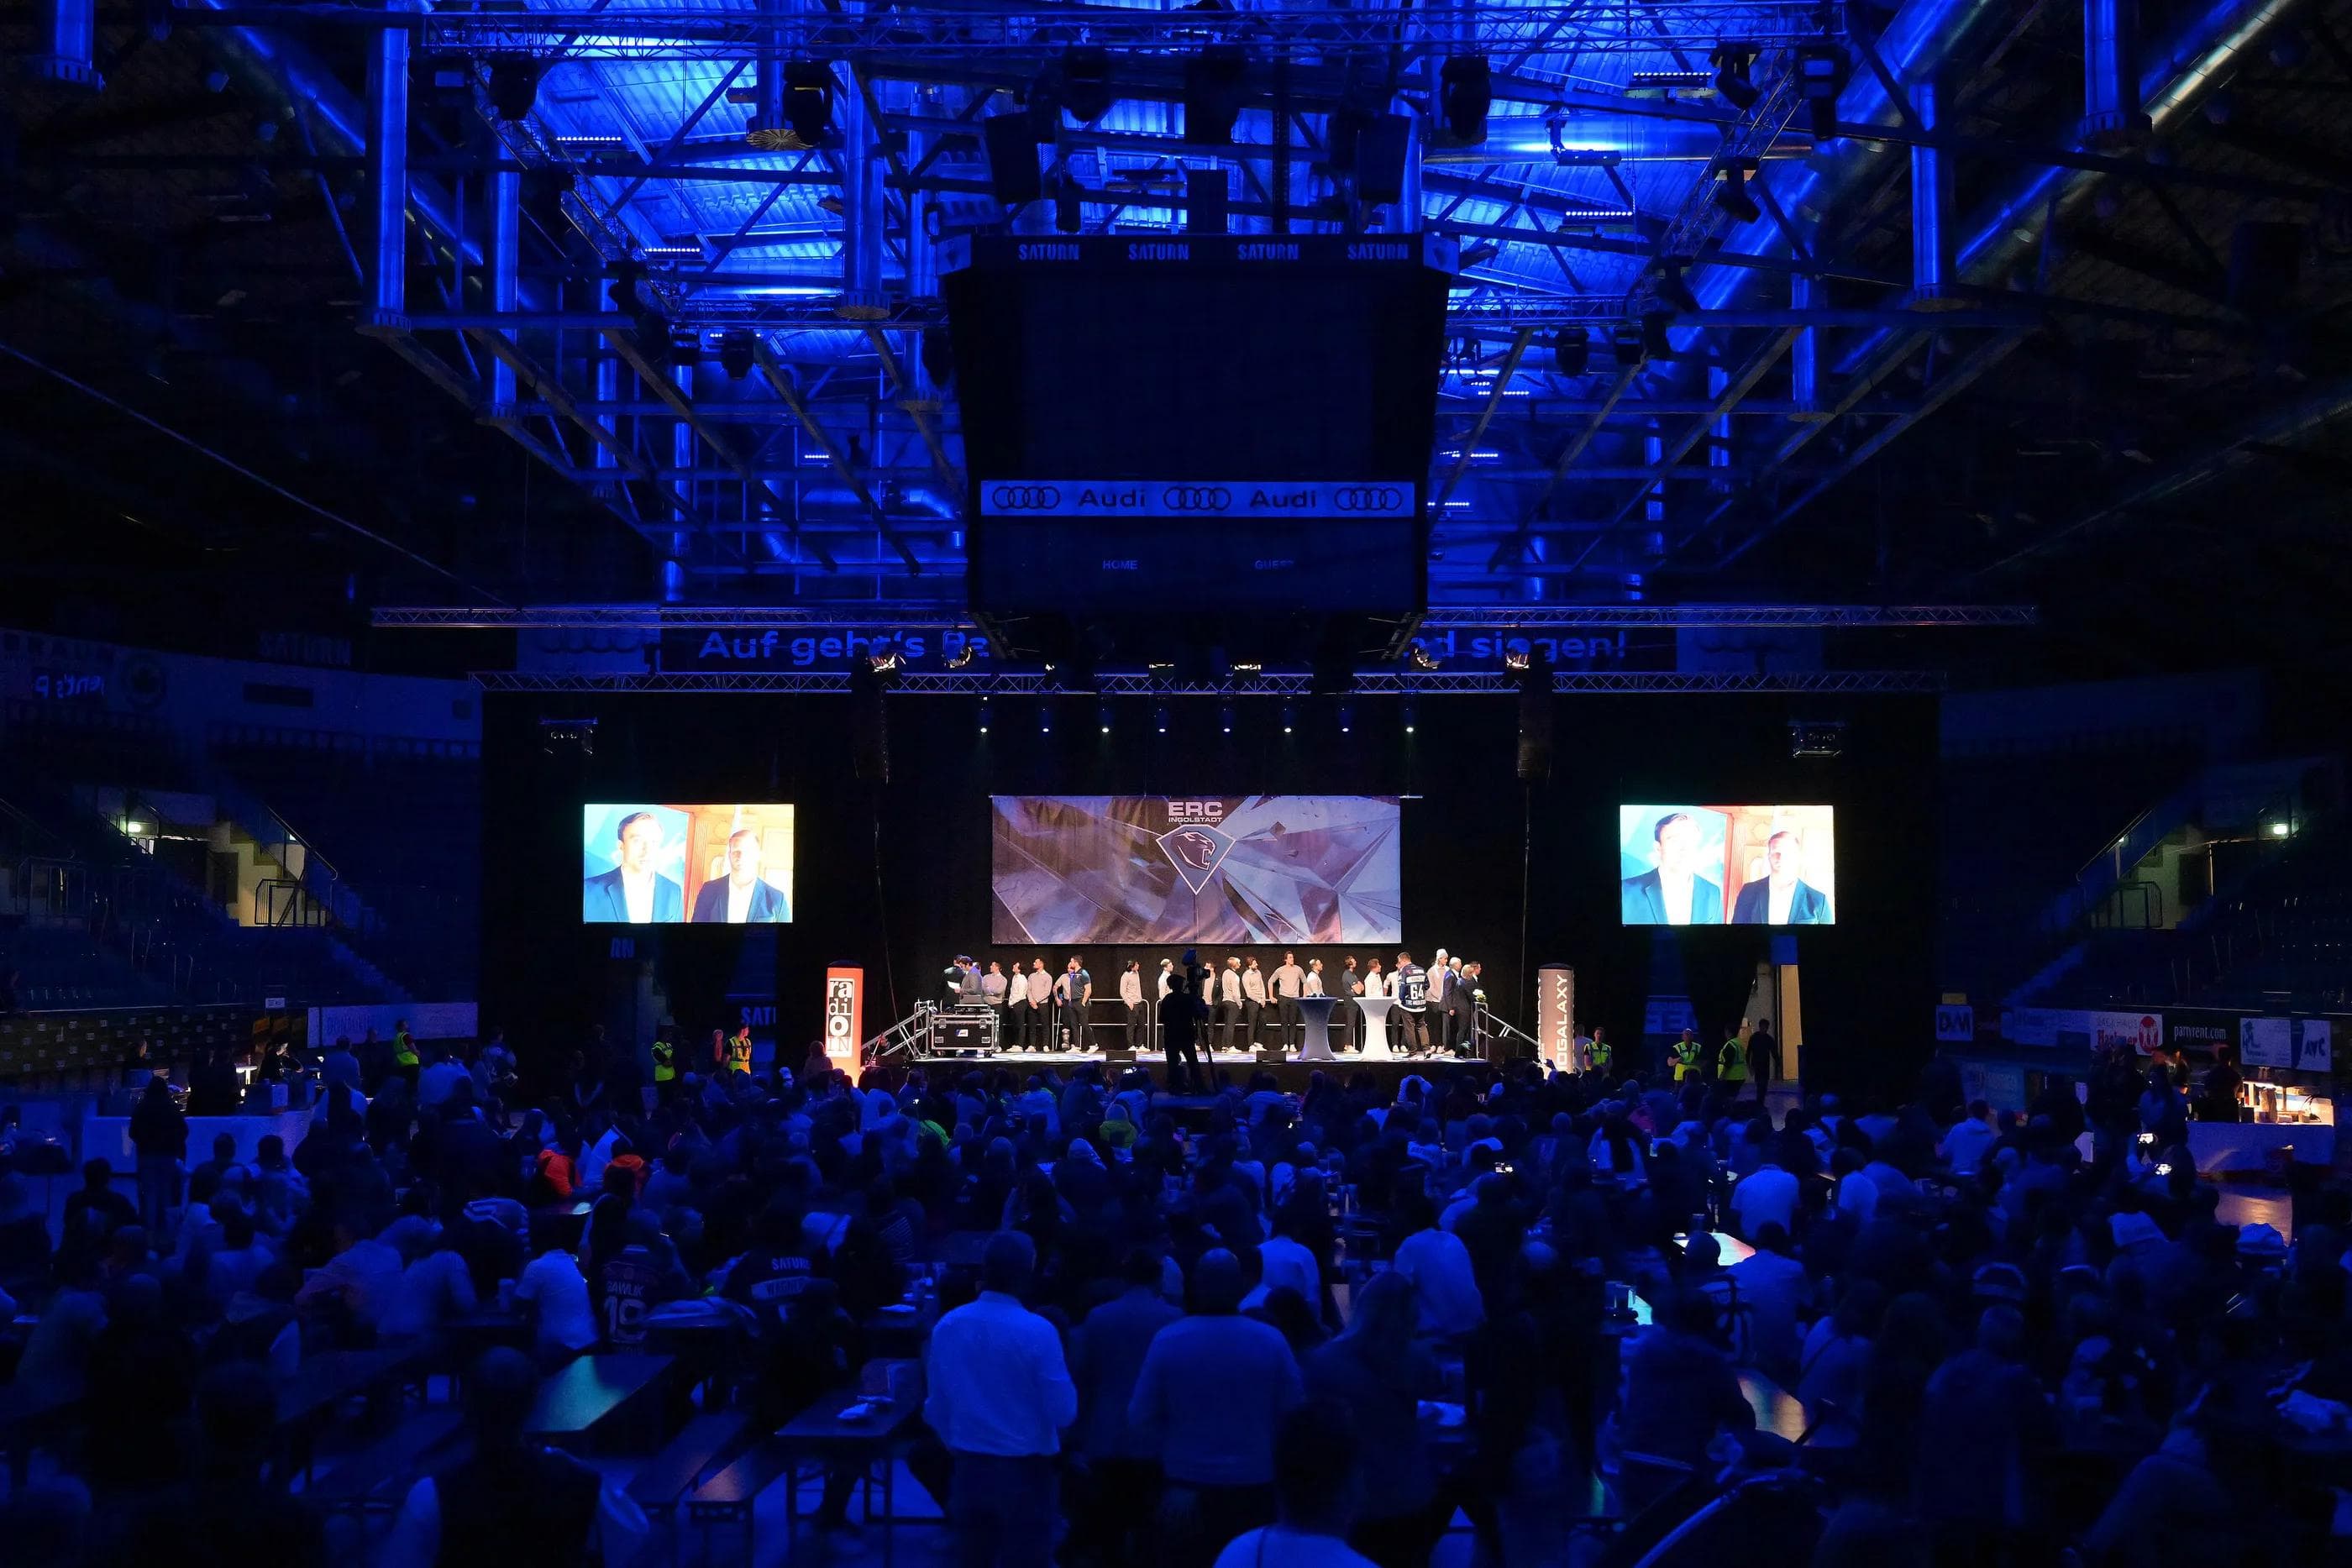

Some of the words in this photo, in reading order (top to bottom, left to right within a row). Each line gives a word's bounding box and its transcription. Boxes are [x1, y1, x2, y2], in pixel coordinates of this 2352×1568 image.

[1018, 243, 1079, 261] SATURN
[1128, 243, 1189, 261] SATURN
[1237, 243, 1299, 261] SATURN
[1347, 243, 1409, 261] SATURN
[1079, 489, 1146, 507] Audi
[1250, 489, 1316, 508] Audi
[1102, 559, 1139, 571] HOME
[699, 630, 779, 658] Auf
[1168, 802, 1222, 815] ERC
[1410, 983, 1425, 1000] 64
